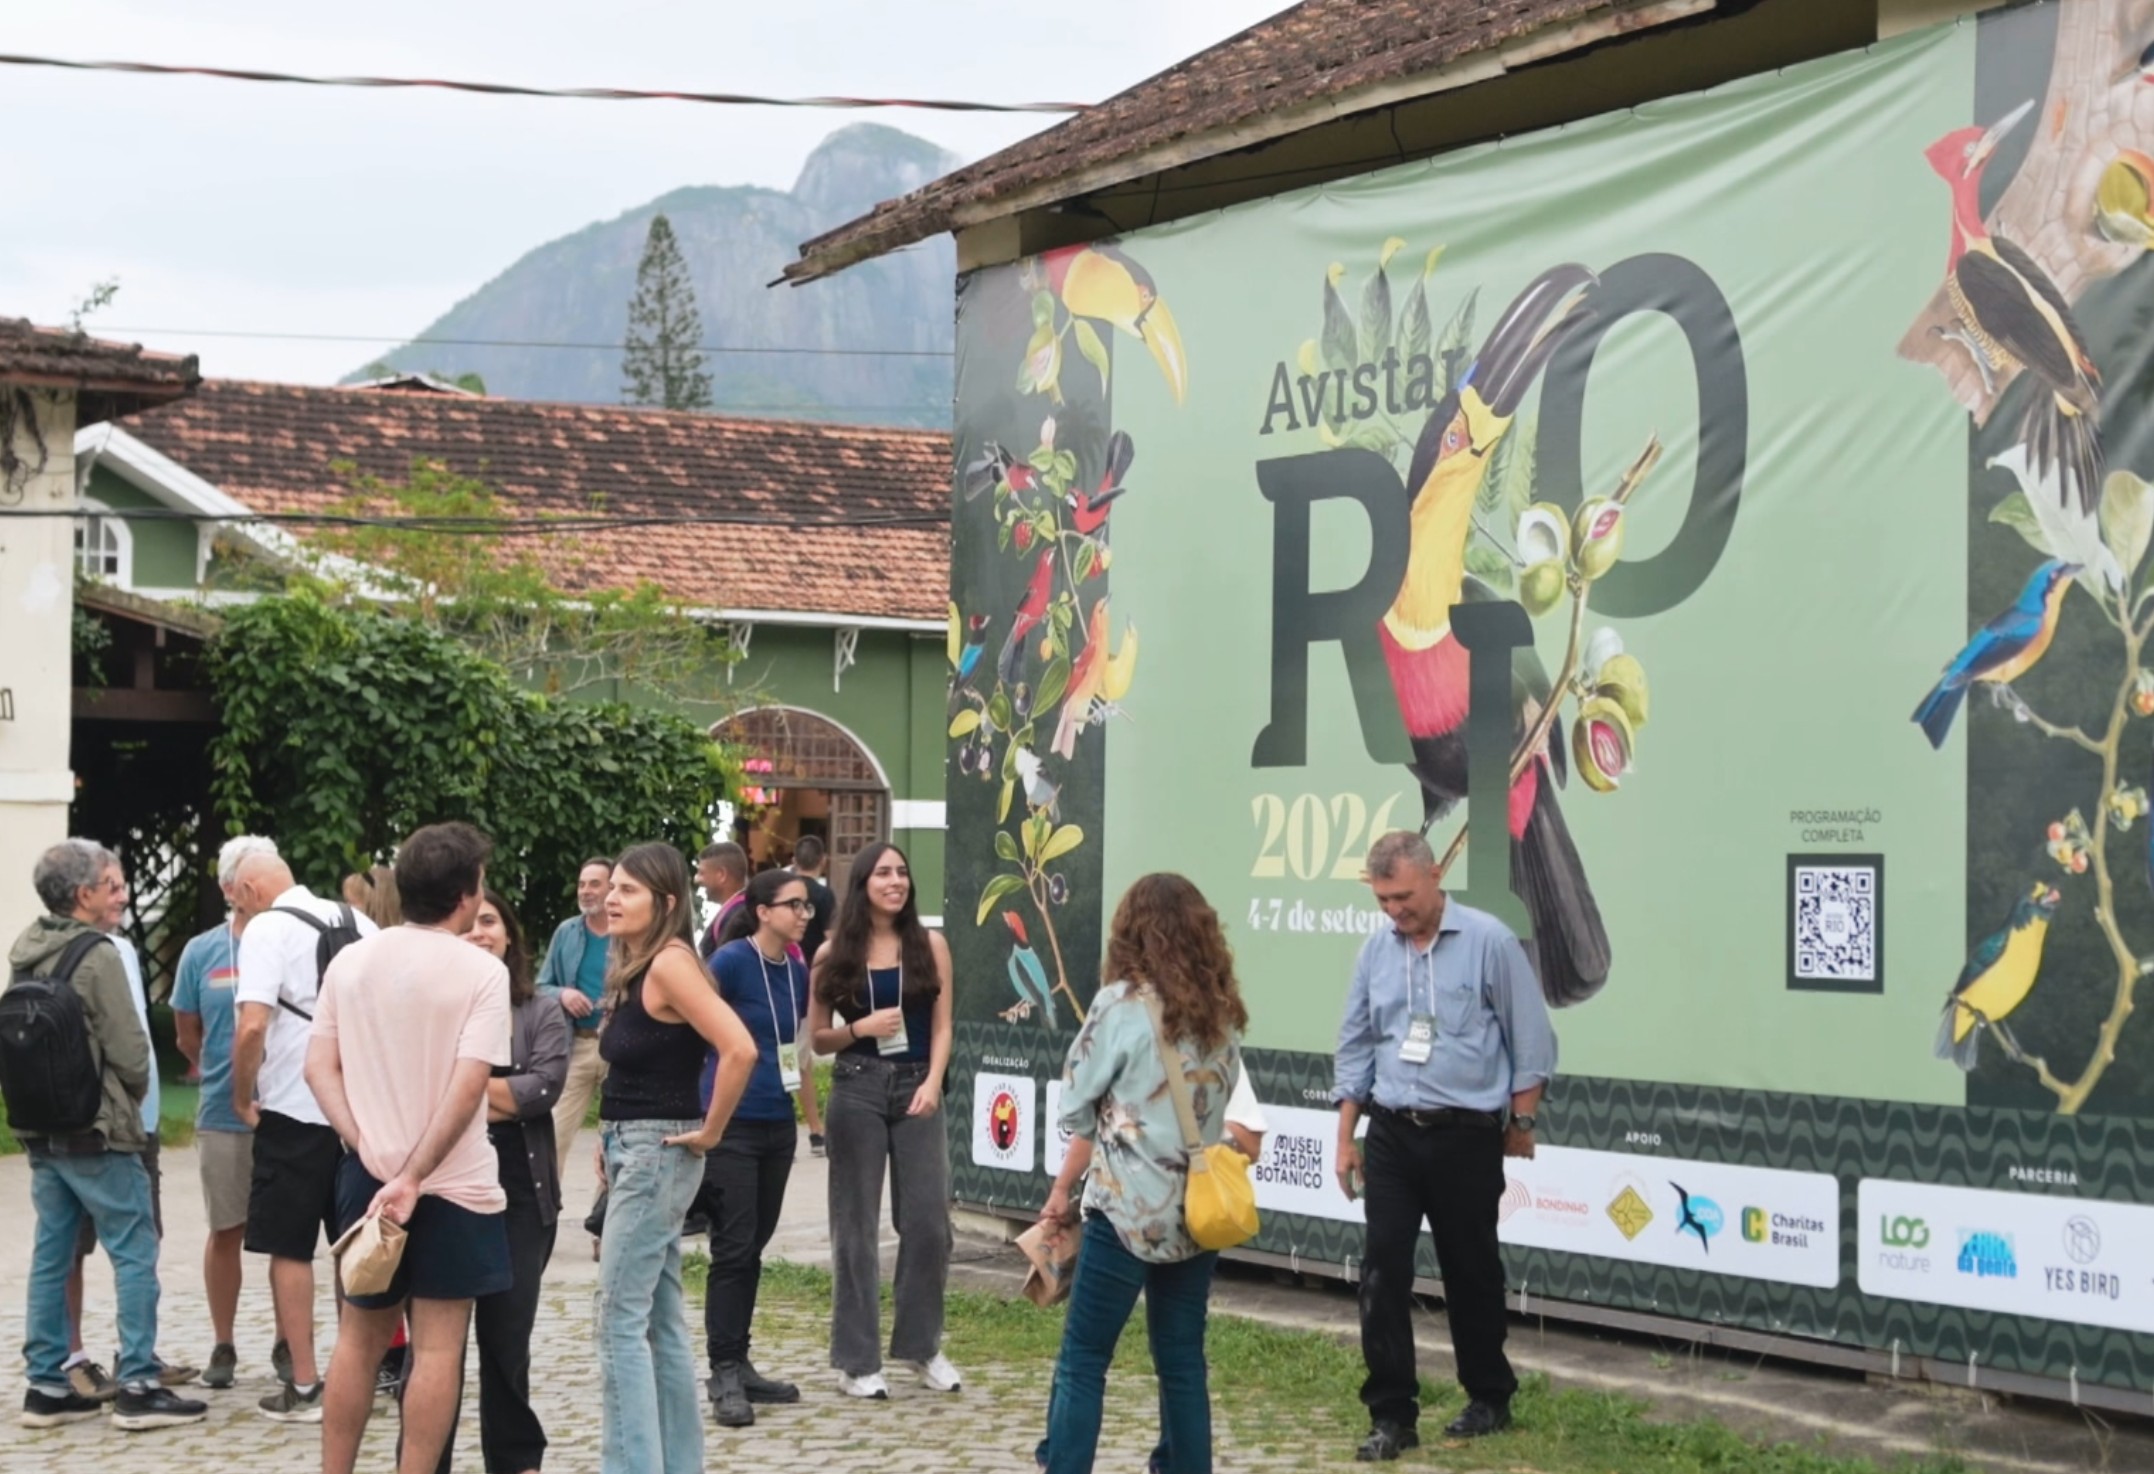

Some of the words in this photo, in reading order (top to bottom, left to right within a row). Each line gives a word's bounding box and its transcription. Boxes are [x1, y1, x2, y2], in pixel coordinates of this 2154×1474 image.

[1259, 345, 1466, 435] Avistar
[1790, 808, 1881, 824] PROGRAMAÇÃO
[1802, 829, 1864, 843] COMPLETA
[1247, 898, 1283, 931] 4-7
[1287, 899, 1315, 932] de
[1274, 1134, 1322, 1155] MUSEU
[1625, 1131, 1661, 1146] APOIO
[1273, 1151, 1322, 1172] JARDIM
[2009, 1166, 2078, 1185] PARCERIA
[1536, 1197, 1588, 1215] BONDINHO
[1772, 1213, 1824, 1232] Charitas
[1772, 1231, 1808, 1248] Brasil
[1879, 1252, 1931, 1273] nature
[2045, 1267, 2076, 1292] YES
[2080, 1270, 2120, 1301] BIRD
